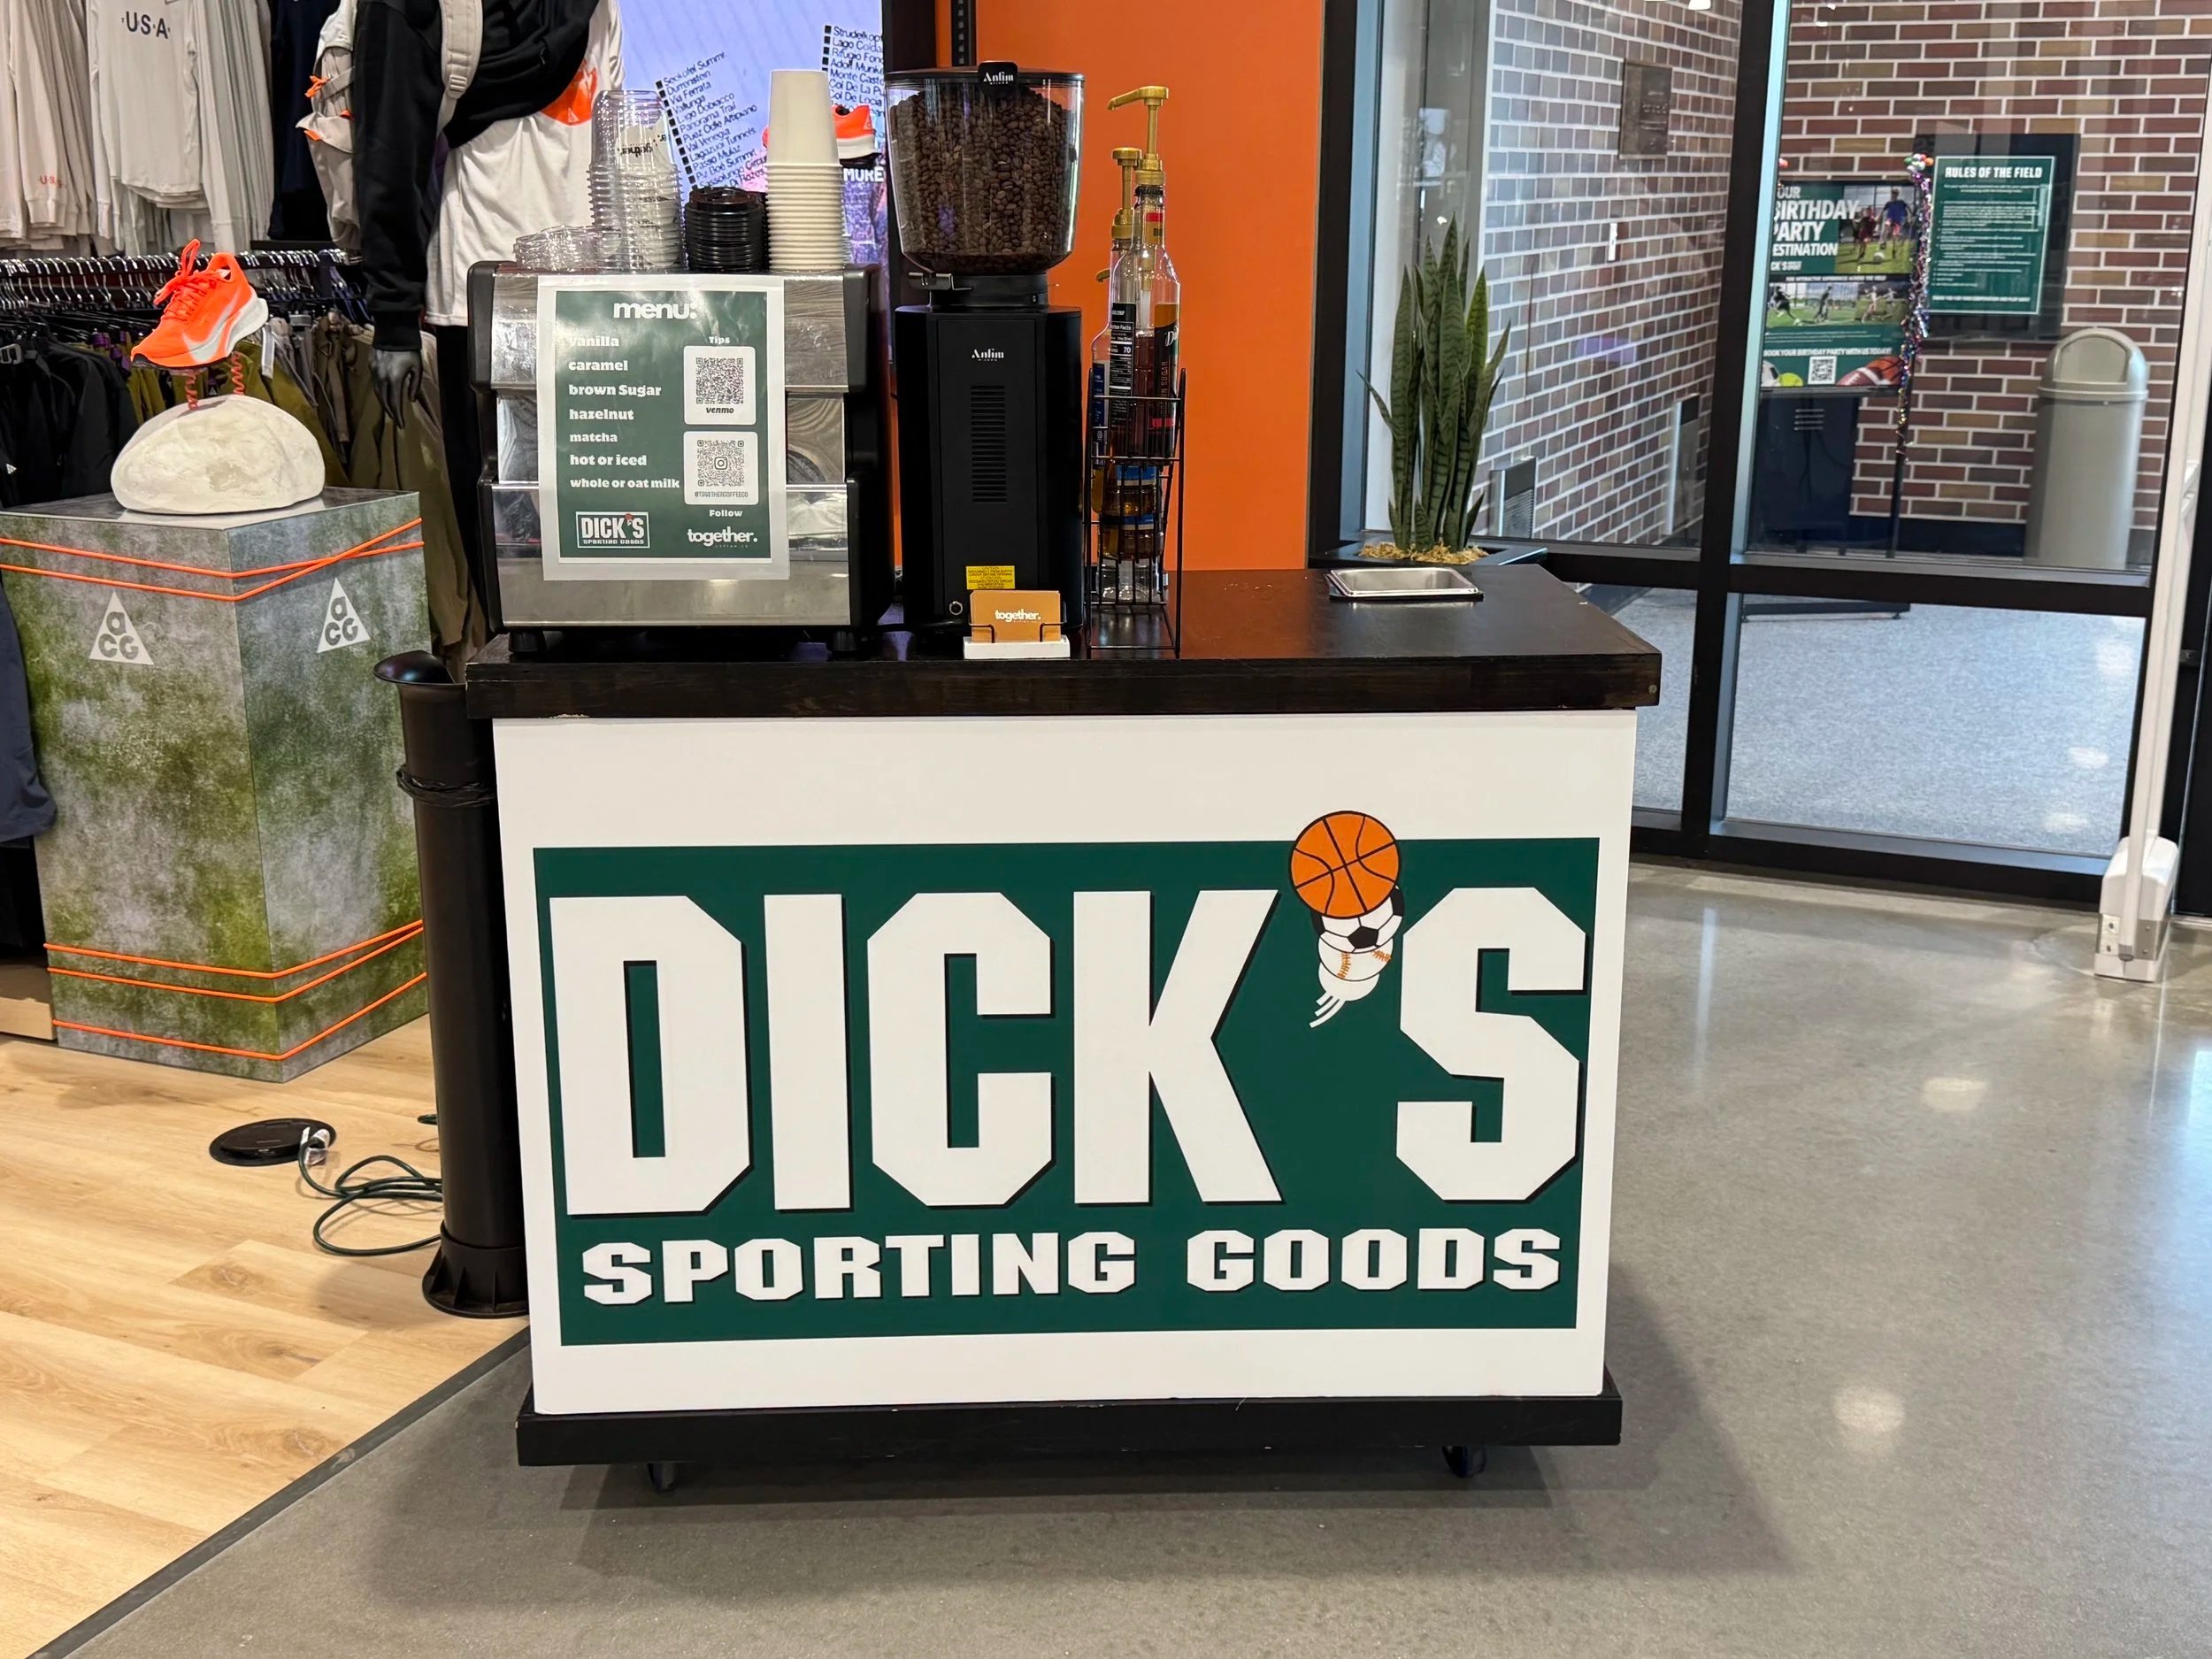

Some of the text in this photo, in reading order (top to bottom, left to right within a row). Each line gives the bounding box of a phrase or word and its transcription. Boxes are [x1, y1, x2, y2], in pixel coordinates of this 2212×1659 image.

[1945, 166, 2043, 178] RULES OF THE FIELD
[1777, 186, 1801, 199] OUR
[1773, 221, 1825, 242] ARTY
[1772, 242, 1839, 257] ESTINATION
[613, 303, 697, 319] menu:
[709, 336, 730, 345] Tips
[568, 360, 628, 372] caramel
[568, 384, 662, 397] brown Sugar
[569, 409, 634, 420] hazelnut
[570, 433, 618, 442] matcha
[570, 454, 648, 466] hot or iced
[570, 478, 680, 488] whole or oat milk
[580, 517, 645, 539] DICK'S
[549, 885, 1589, 1216] DICK'S
[582, 1227, 1562, 1306] SPORTING GOODS
